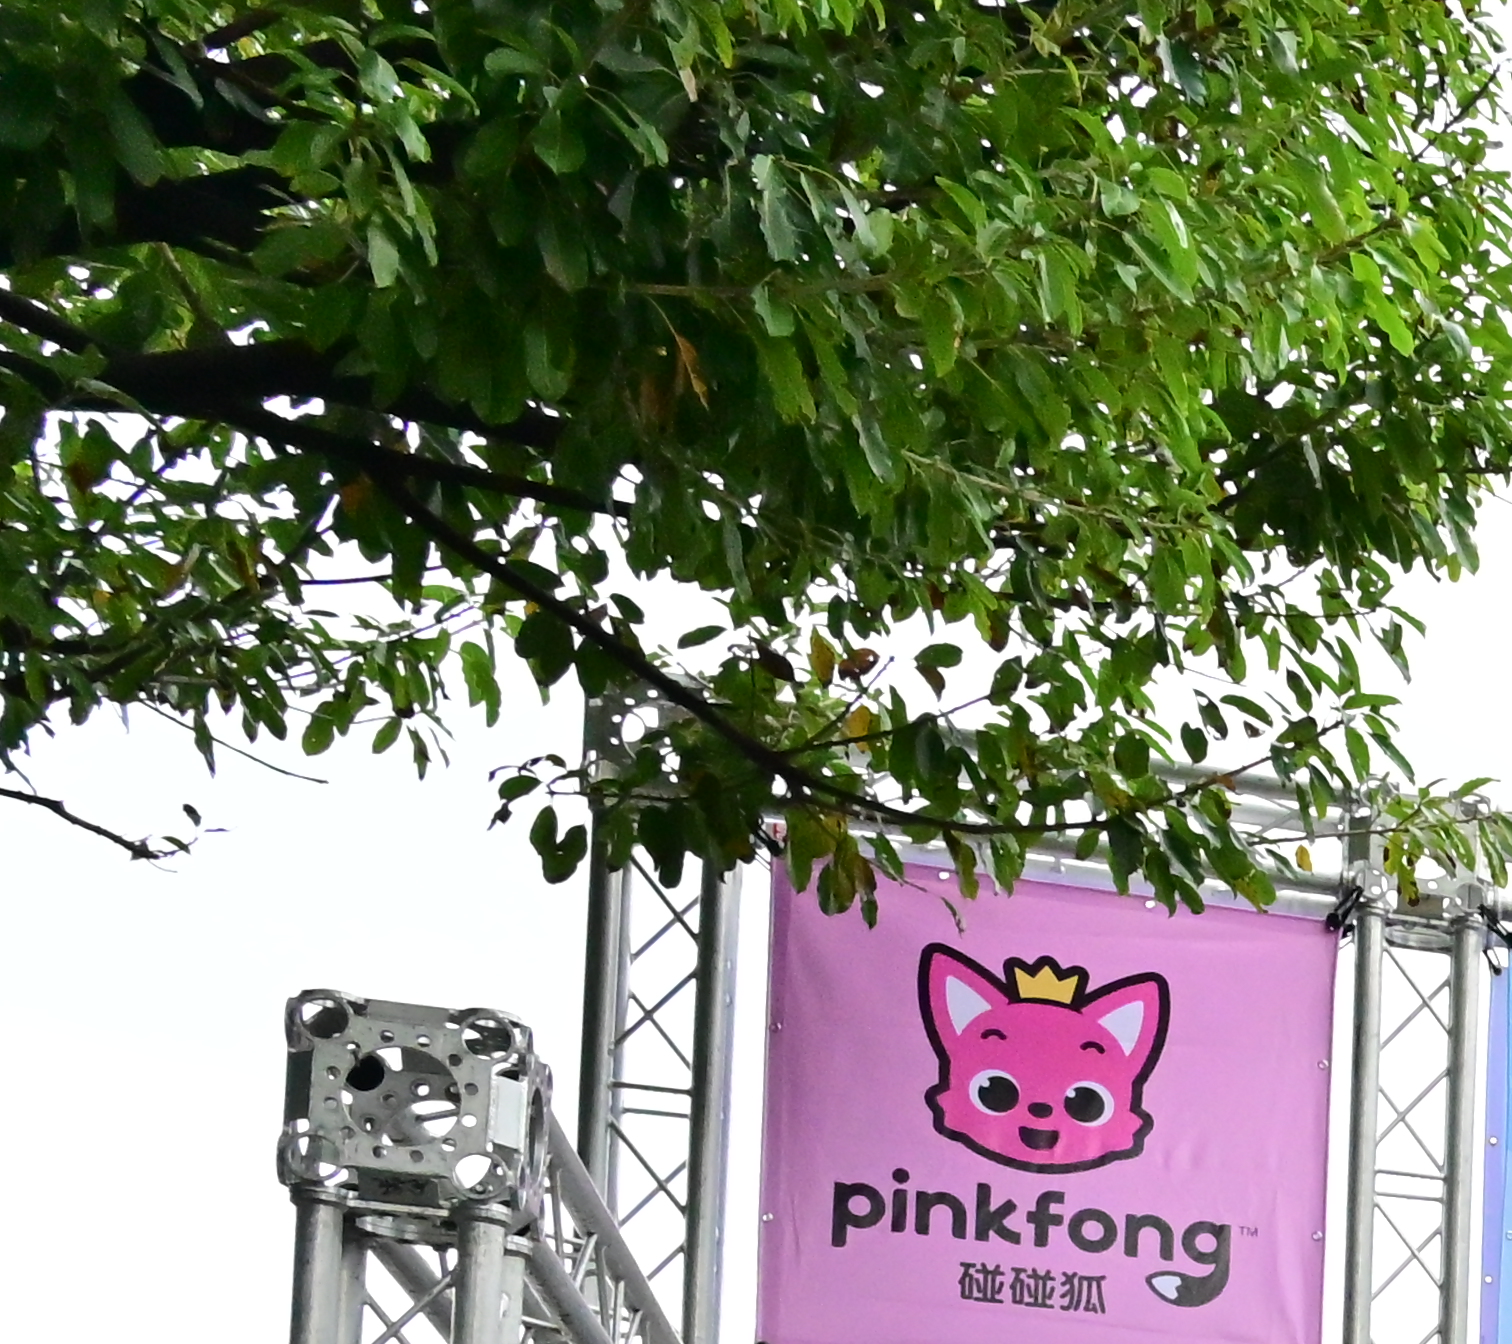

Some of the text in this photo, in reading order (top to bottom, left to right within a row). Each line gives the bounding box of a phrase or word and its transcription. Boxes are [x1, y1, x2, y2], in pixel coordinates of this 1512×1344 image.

[831, 1168, 1232, 1307] pinkfong
[957, 1260, 1108, 1315] 碰碰狐
